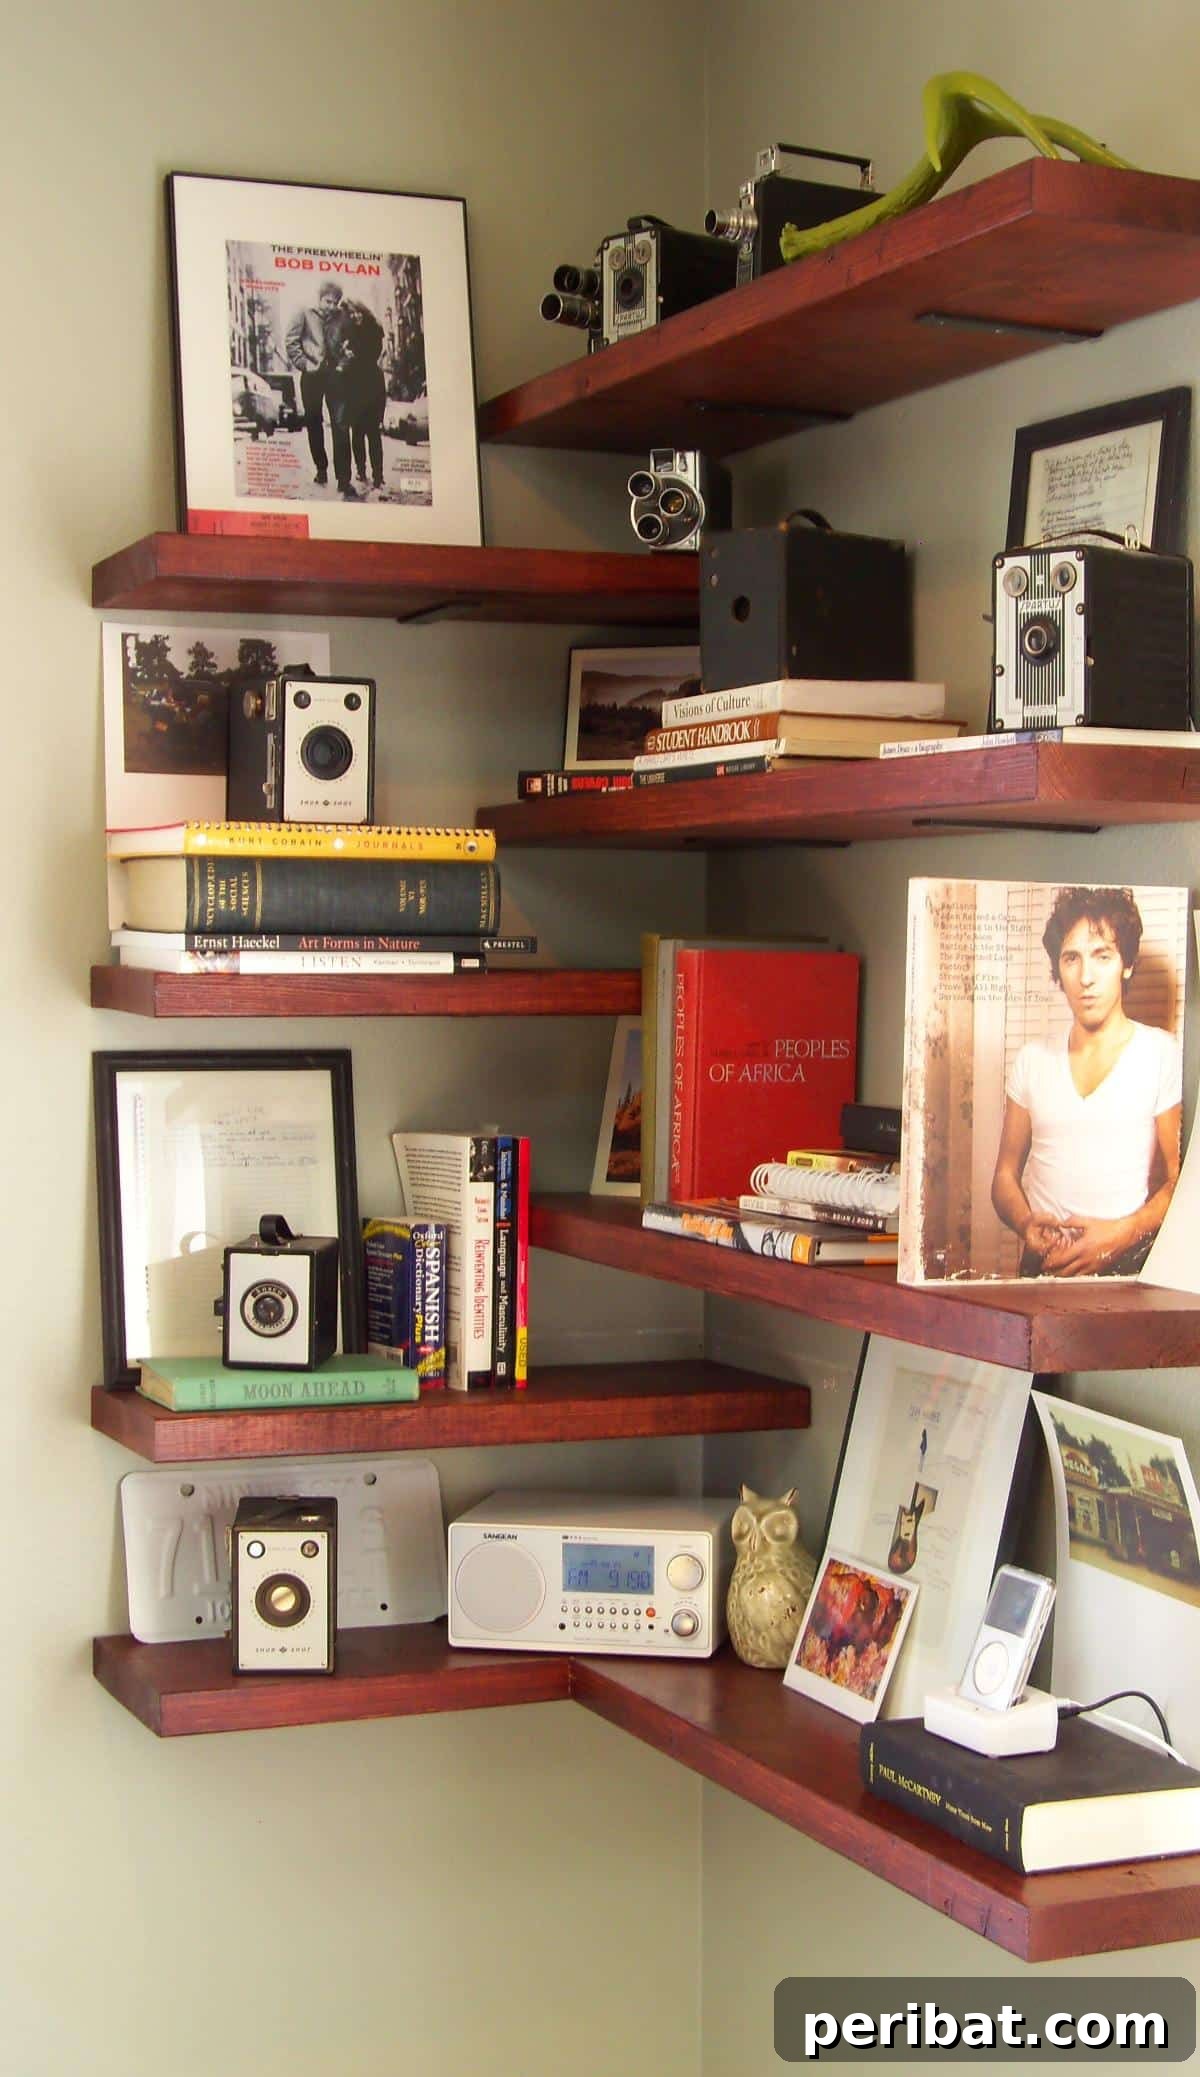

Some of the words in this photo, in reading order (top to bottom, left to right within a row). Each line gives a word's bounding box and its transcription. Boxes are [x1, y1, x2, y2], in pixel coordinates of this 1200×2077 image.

[271, 244, 293, 254] THE
[297, 246, 383, 261] FREEWHEELIN'
[274, 257, 314, 270] BOB
[319, 261, 381, 277] DYLAN
[673, 702, 703, 718] Visions
[705, 697, 716, 713] of
[716, 693, 751, 713] Culture
[656, 728, 698, 752] STUDENT
[698, 720, 752, 746] HANDBOOK
[229, 837, 263, 846] KURT
[272, 838, 322, 846] COBAIN
[356, 841, 424, 850] JOURNALS
[230, 876, 238, 912] SOCIAL
[241, 871, 249, 917] SCIENCES
[194, 935, 227, 949] Ernst
[232, 935, 280, 949] Haeckel
[299, 937, 318, 949] Art
[323, 936, 359, 949] Forms
[364, 936, 374, 949] in
[378, 937, 420, 949] Nature
[493, 941, 524, 949] PRESTEL
[301, 955, 361, 968] LISTEN
[675, 973, 685, 1057] PEOPLES
[775, 1039, 849, 1059] PEOPLES
[673, 1063, 683, 1092] OF
[709, 1064, 736, 1082] OF
[738, 1064, 806, 1083] AFRICA
[672, 1096, 682, 1170] AFRICA
[412, 1231, 443, 1241] Oxford
[497, 1229, 509, 1277] Language
[474, 1240, 489, 1294] REINVENTING
[413, 1249, 423, 1313] Dictionary
[425, 1248, 440, 1343] SPANISH
[414, 1313, 423, 1344] Plus
[474, 1295, 488, 1340] IDENTITIES
[497, 1295, 508, 1353] Masculinity
[518, 1337, 528, 1368] USED
[244, 1383, 293, 1400] MOON
[300, 1380, 365, 1398] AHEAD
[483, 1533, 518, 1541] SANGEAN
[567, 1568, 589, 1586] FM
[879, 1764, 897, 1784] PAUL
[898, 1775, 942, 1807] McCARTNEY
